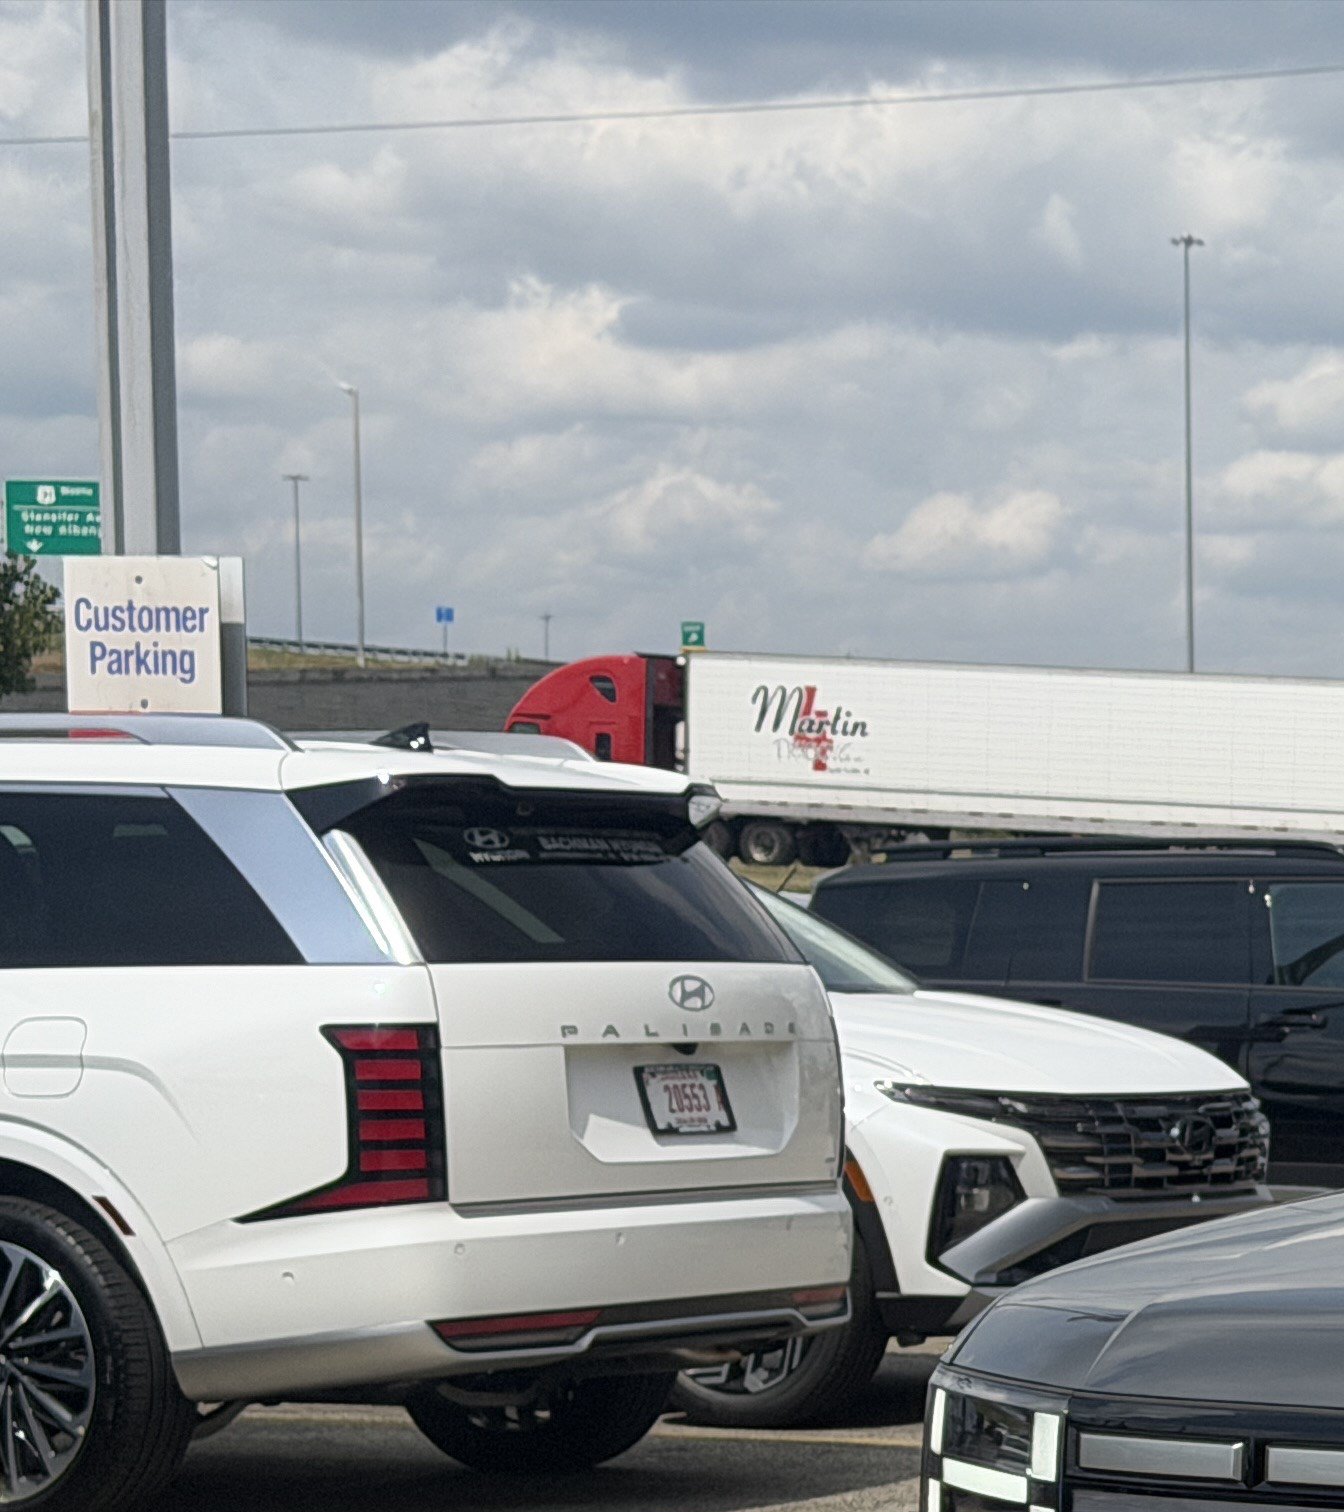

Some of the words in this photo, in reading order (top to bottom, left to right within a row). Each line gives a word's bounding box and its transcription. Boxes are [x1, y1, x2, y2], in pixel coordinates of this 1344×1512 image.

[74, 597, 209, 633] Customer
[90, 641, 195, 684] Parking
[751, 685, 868, 737] Martin
[561, 1022, 797, 1038] PALISADE
[663, 1083, 711, 1113] 20553
